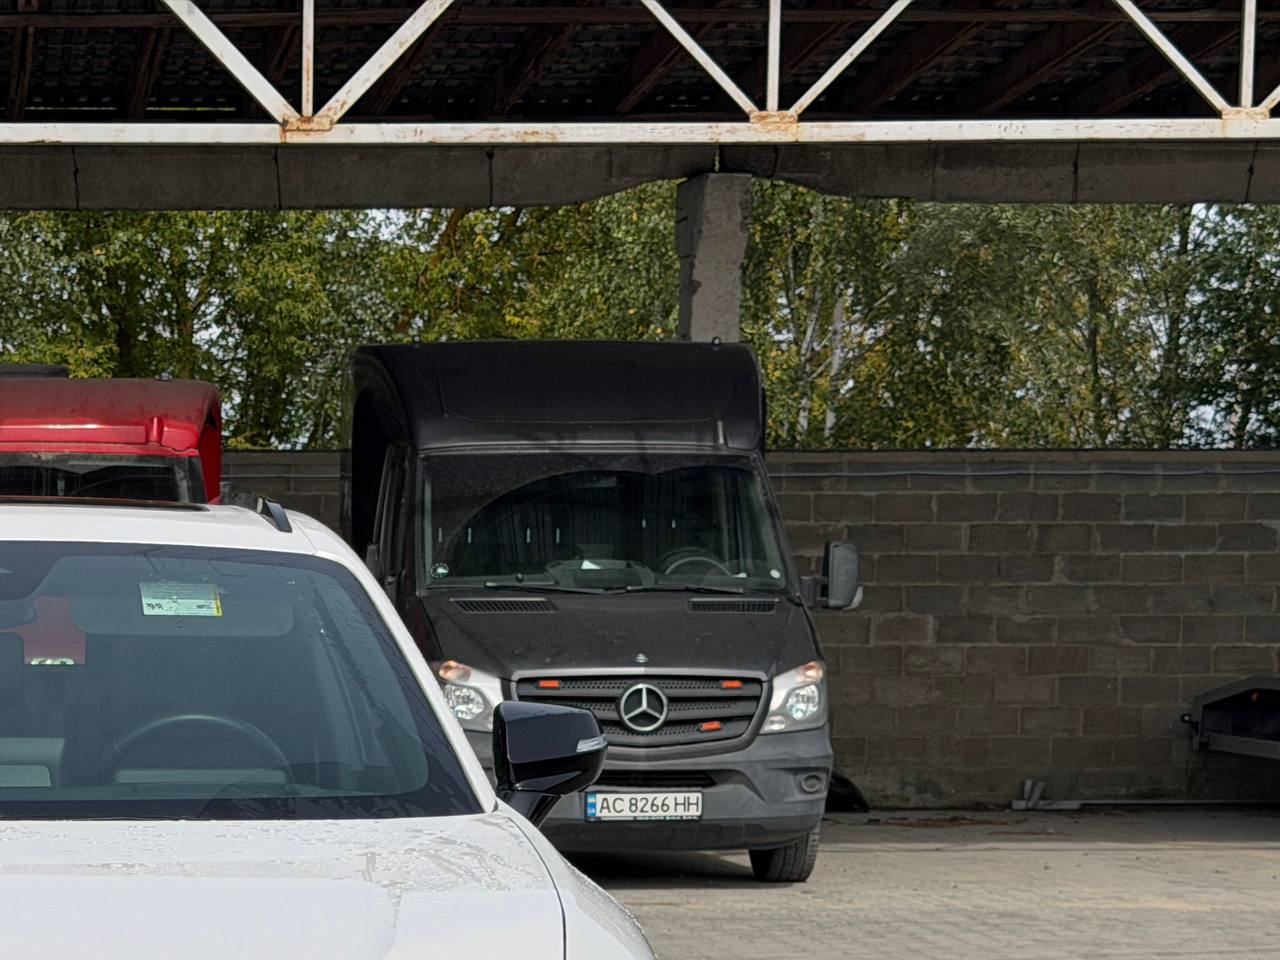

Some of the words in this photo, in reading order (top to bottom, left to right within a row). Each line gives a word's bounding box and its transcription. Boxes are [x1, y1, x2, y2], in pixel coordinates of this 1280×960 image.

[599, 797, 624, 813] AC
[628, 797, 670, 813] 8266
[674, 796, 700, 812] HH
